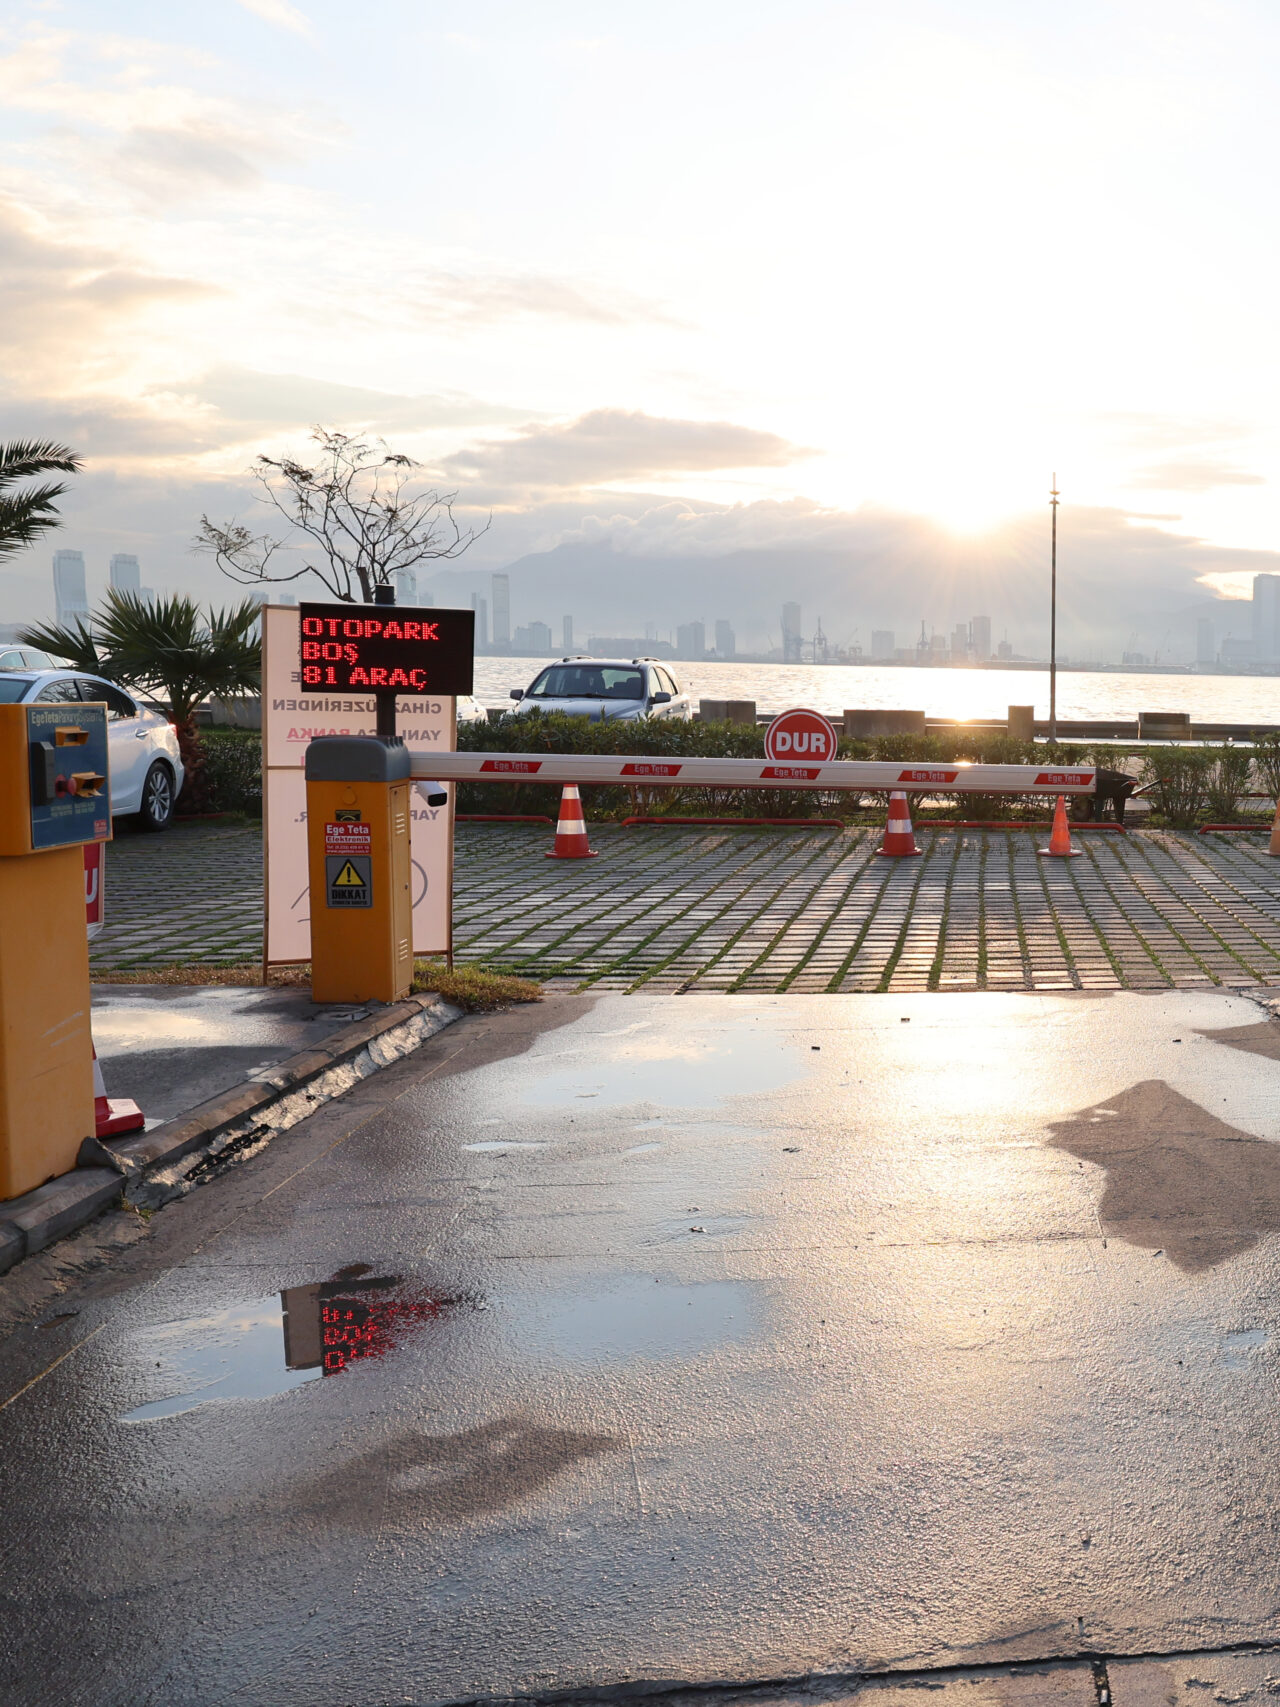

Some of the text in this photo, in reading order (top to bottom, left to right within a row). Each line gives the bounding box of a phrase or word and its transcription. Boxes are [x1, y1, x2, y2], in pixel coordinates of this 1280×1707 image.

[303, 617, 440, 640] OTOPARK
[303, 641, 359, 665] BOŞ
[303, 666, 337, 684] 81
[350, 667, 427, 690] ARAÇ
[776, 731, 826, 753] DUR
[634, 764, 649, 774] Ege
[774, 767, 808, 777] Ege Teta
[911, 770, 945, 780] Ege Teta
[1048, 774, 1063, 783] Ege
[326, 824, 369, 836] Ege Teta
